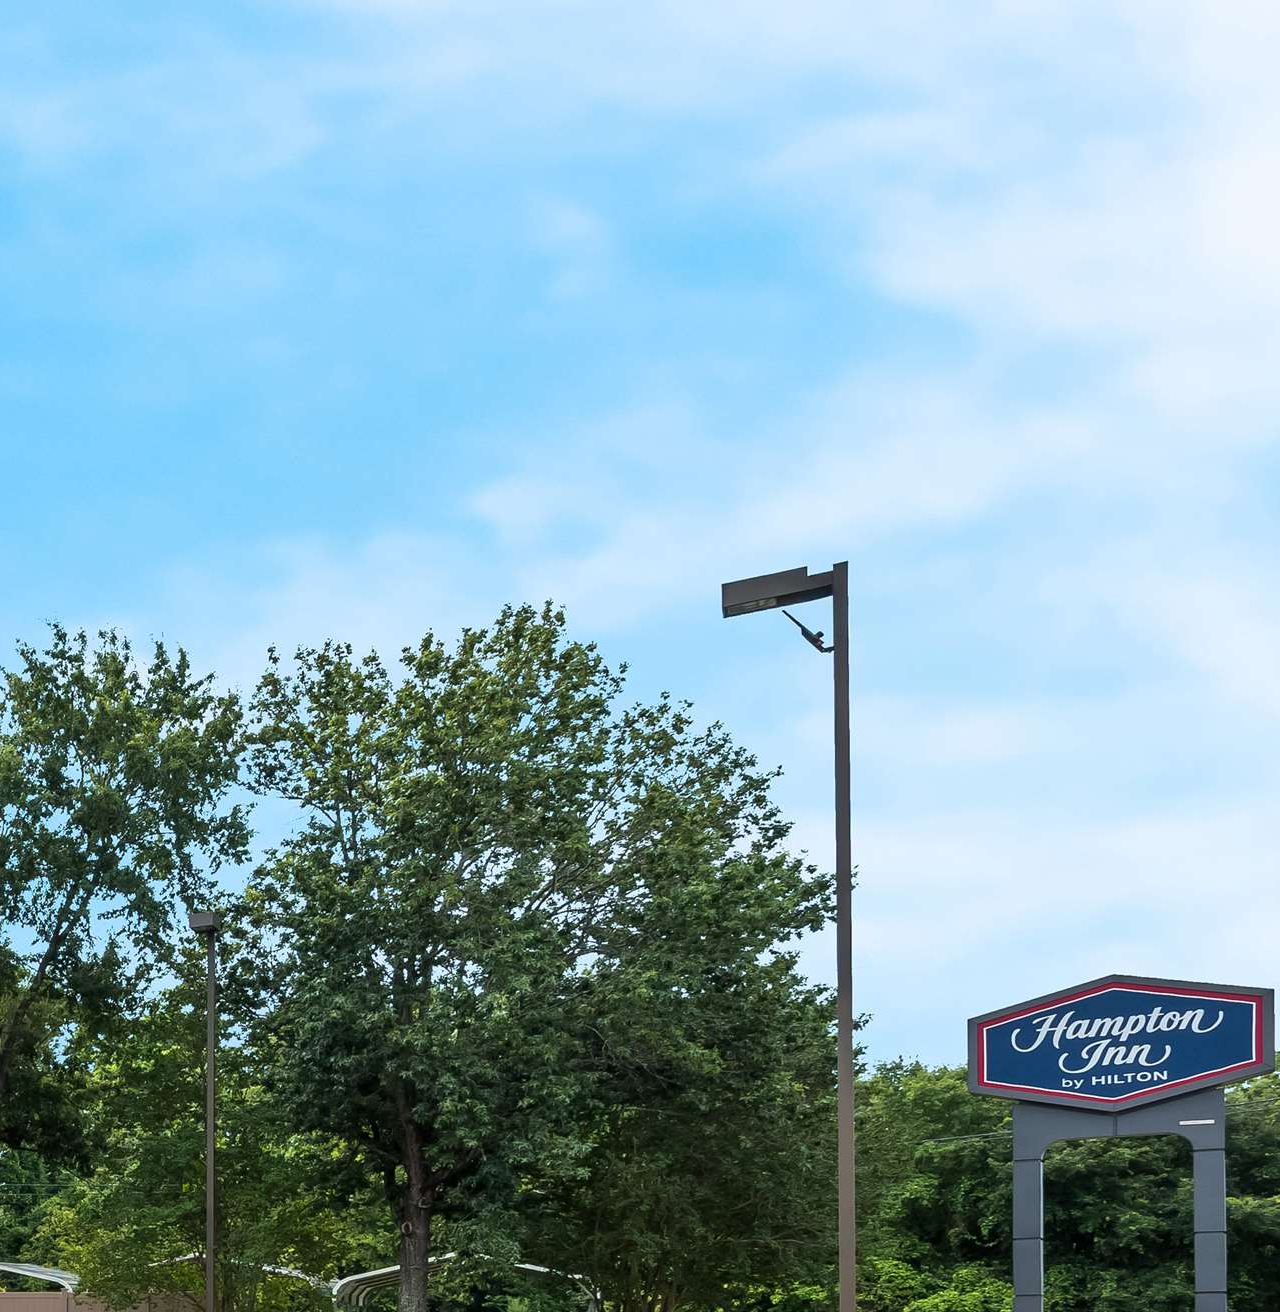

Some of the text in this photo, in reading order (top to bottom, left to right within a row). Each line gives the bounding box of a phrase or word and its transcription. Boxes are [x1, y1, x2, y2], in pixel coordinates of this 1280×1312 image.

[1011, 1007, 1224, 1053] Hampton
[1058, 1039, 1171, 1074] Inn
[1061, 1070, 1169, 1090] by HILTON
